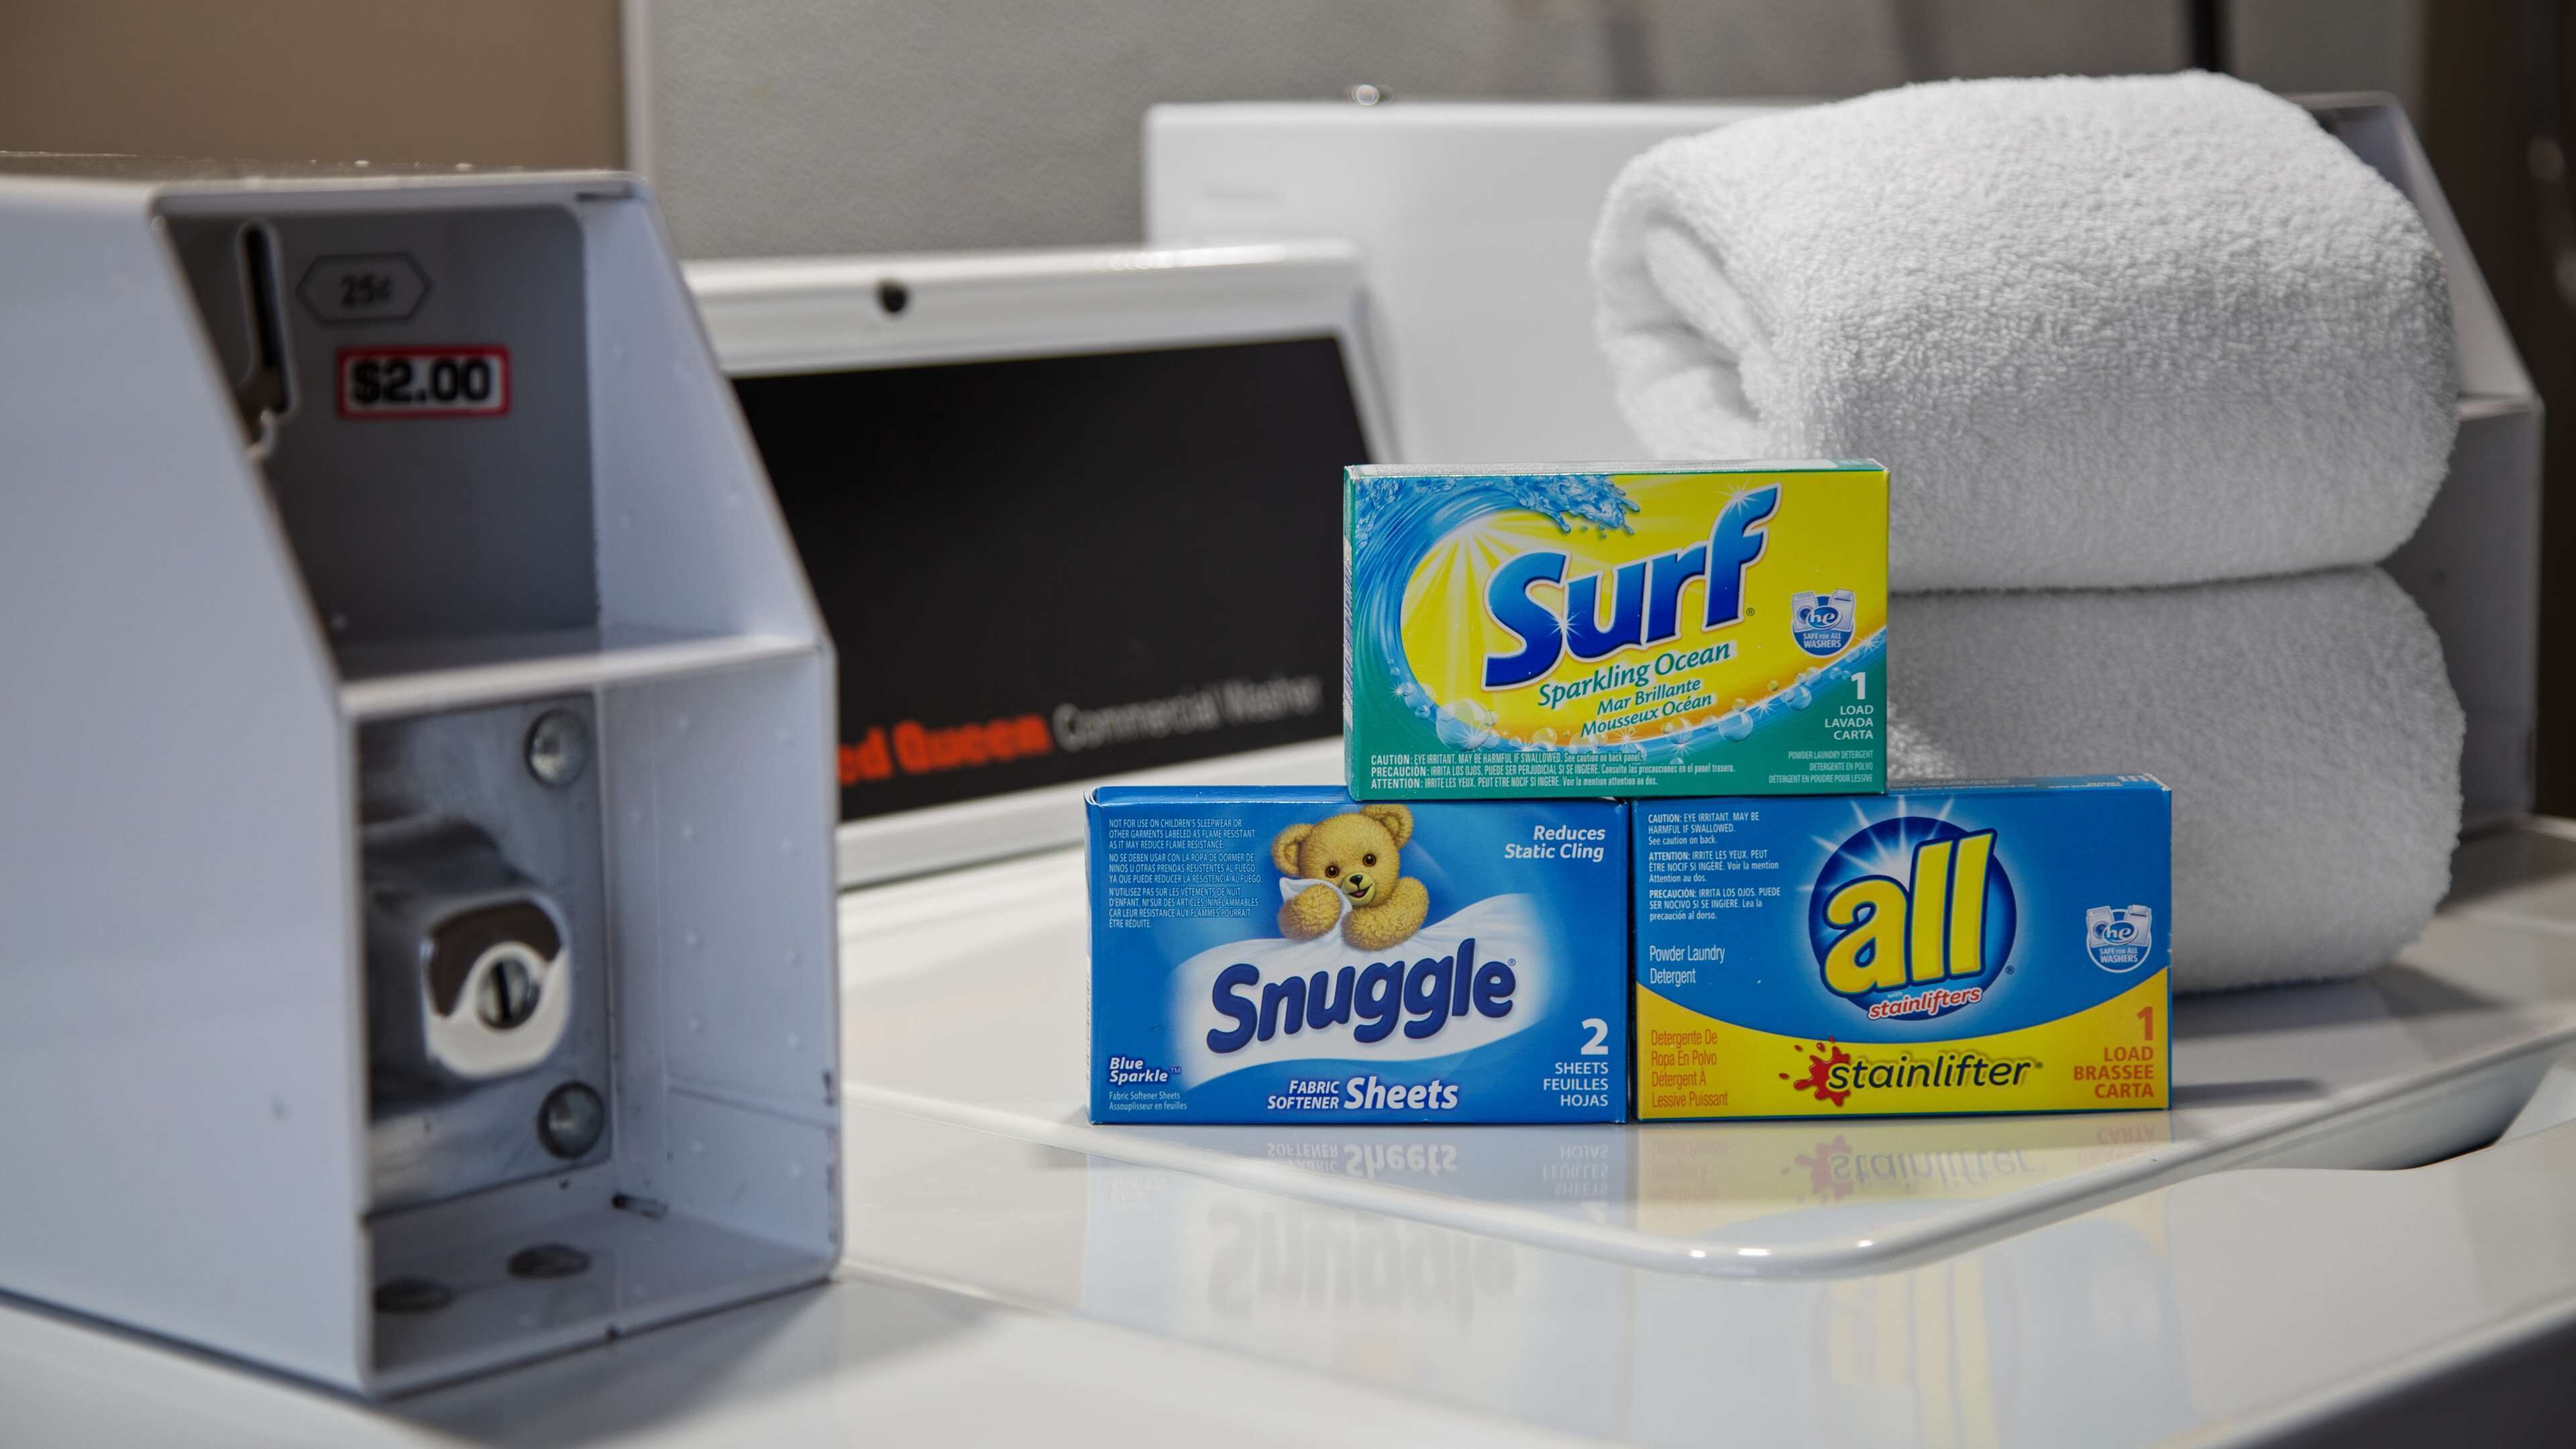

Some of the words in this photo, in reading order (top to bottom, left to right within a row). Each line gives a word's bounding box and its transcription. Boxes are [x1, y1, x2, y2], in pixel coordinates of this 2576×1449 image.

[351, 358, 492, 405] $2.00
[1483, 482, 1782, 691] Surf
[1803, 639, 1841, 648] WASHERS
[1538, 664, 1650, 710] Sparkling
[1655, 643, 1729, 676] Ocean
[1851, 672, 1866, 700] 1
[1597, 698, 1631, 715] Mar
[1635, 680, 1701, 705] Brillante
[1580, 708, 1658, 737] Mousseux
[1662, 695, 1712, 716] Océan
[1840, 706, 1874, 715] LOAD
[1825, 718, 1874, 728] LAVADA
[1833, 731, 1874, 740] CARTA
[837, 728, 892, 787] ed
[1415, 755, 1425, 764] EYE
[1427, 754, 1456, 764] IRRITANT.
[1458, 754, 1472, 763] MAY
[1474, 753, 1481, 763] BE
[1483, 753, 1512, 763] HARMFUL
[1514, 753, 1519, 763] IF
[1521, 753, 1562, 763] SWALLOWED.
[1564, 753, 1574, 762] See
[1577, 753, 1598, 762] caution
[1609, 753, 1622, 762] back
[1624, 752, 1642, 763] panel.
[1788, 751, 1813, 759] POWDER
[1814, 751, 1840, 759] LAUNDRY
[1841, 750, 1874, 758] DETERGENT
[1810, 763, 1845, 771] DETERGENTE
[1855, 762, 1873, 770] POLVO
[1803, 775, 1809, 783] EN
[1835, 774, 1850, 782] POUR
[1110, 819, 1122, 827] NOT
[1124, 819, 1135, 827] FOR
[1137, 819, 1148, 827] USE
[1150, 819, 1159, 827] ON
[1197, 819, 1231, 827] SLEEPWEAR
[1233, 819, 1242, 827] OR
[1648, 814, 1682, 822] CAUTION:
[1684, 814, 1696, 822] EYE
[1699, 813, 1730, 822] IRRITANT.
[1733, 813, 1748, 821] MAY
[1751, 812, 1759, 820] BE
[1110, 830, 1128, 838] OTHER
[1131, 830, 1163, 838] GARMENTS
[1165, 830, 1191, 838] LABELED
[1193, 830, 1200, 838] AS
[1202, 830, 1222, 838] FLAME
[1224, 830, 1255, 838] RESISTANT
[1534, 826, 1605, 841] Reduces
[1648, 825, 1680, 834] HARMFUL
[1683, 824, 1688, 833] IF
[1691, 824, 1735, 833] SWALLOWED.
[1649, 837, 1660, 845] See
[1663, 836, 1687, 845] caution
[1700, 835, 1717, 843] back.
[1505, 843, 1556, 859] Static
[1560, 844, 1604, 862] Cling
[1649, 852, 1690, 861] ATTENTION:
[1693, 851, 1713, 859] IRRITE
[1715, 851, 1727, 859] LES
[1729, 850, 1748, 859] YEUX.
[1751, 849, 1768, 858] PEUT
[1668, 863, 1688, 871] NOCIF
[1690, 862, 1696, 871] SI
[1727, 861, 1740, 870] Voir
[1743, 861, 1749, 869] la
[1752, 861, 1778, 869] mention
[1649, 873, 1680, 883] Attention
[1693, 873, 1707, 881] dos.
[1650, 888, 1697, 898] PRECAUCIÓN:
[1699, 889, 1720, 897] IRRITA
[1723, 888, 1735, 897] LOS
[1738, 888, 1756, 896] OJOS.
[1759, 888, 1780, 896] PUEDE
[1650, 900, 1662, 910] SER
[1664, 900, 1690, 909] NOCIVO
[1693, 900, 1699, 908] SI
[1701, 900, 1709, 908] SE
[1711, 899, 1739, 908] INGIERE.
[1743, 899, 1754, 907] Lea
[1756, 898, 1762, 907] la
[1650, 911, 1686, 922] precaución
[1688, 911, 1694, 919] al
[1697, 910, 1717, 919] dorso.
[1822, 829, 1996, 996] all
[1650, 945, 1685, 961] Powder
[1688, 945, 1725, 963] Laundry
[1650, 968, 1696, 987] Detergent
[1206, 938, 1516, 1054] Snuggle
[1888, 990, 1902, 999] with
[1869, 988, 1982, 1020] stainlifters
[2137, 1006, 2153, 1040] 1
[1580, 1018, 1608, 1055] 2
[1652, 1030, 1702, 1049] Detergente
[1705, 1030, 1717, 1044] De
[1652, 1051, 1674, 1069] Ropa
[1678, 1051, 1689, 1065] En
[1693, 1050, 1717, 1065] Polvo
[2104, 1046, 2153, 1061] LOAD
[1110, 1057, 1143, 1071] Blue
[1556, 1063, 1608, 1074] SHEETS
[1110, 1069, 1168, 1085] Sparkle
[1652, 1071, 1697, 1089] Détergent
[1699, 1068, 1706, 1085] À
[1828, 1055, 2031, 1089] stainlifter
[2074, 1065, 2153, 1080] BRASSEE
[1289, 1080, 1339, 1094] FABRIC
[1544, 1079, 1608, 1090] FEUILLES
[2094, 1083, 2153, 1097] CARTA
[1110, 1092, 1128, 1100] Fabric
[1130, 1091, 1157, 1100] Softener
[1159, 1091, 1180, 1099] Sheets
[1344, 1075, 1458, 1110] Sheets
[1653, 1093, 1686, 1107] Lessive
[1689, 1091, 1728, 1106] Puissant
[1110, 1101, 1152, 1112] Assouplisseur
[1164, 1101, 1187, 1110] feuilles
[1267, 1096, 1338, 1110] SOFTENER
[1561, 1095, 1608, 1107] HOJAS
